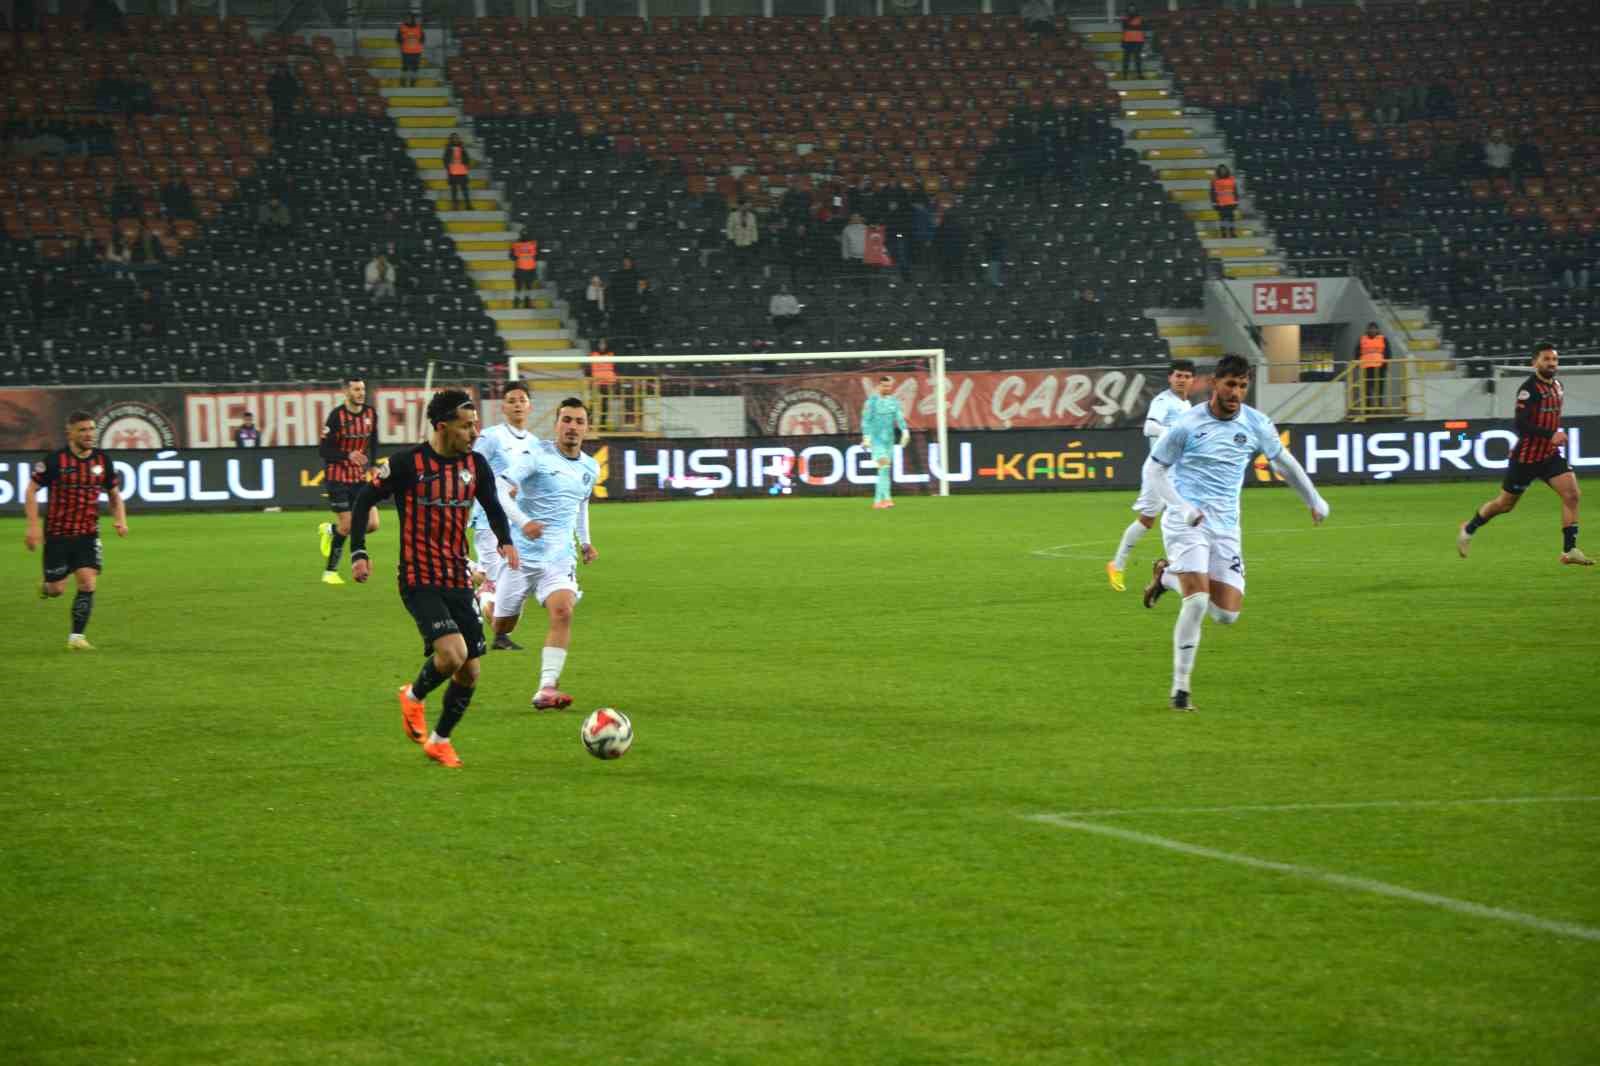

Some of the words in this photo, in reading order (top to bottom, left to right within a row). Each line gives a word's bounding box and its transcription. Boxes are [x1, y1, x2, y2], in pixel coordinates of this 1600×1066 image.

[1255, 287, 1277, 311] E4
[1292, 286, 1314, 310] E5
[991, 370, 1146, 430] ÇARŞI
[1305, 427, 1600, 480] HIŞIROL
